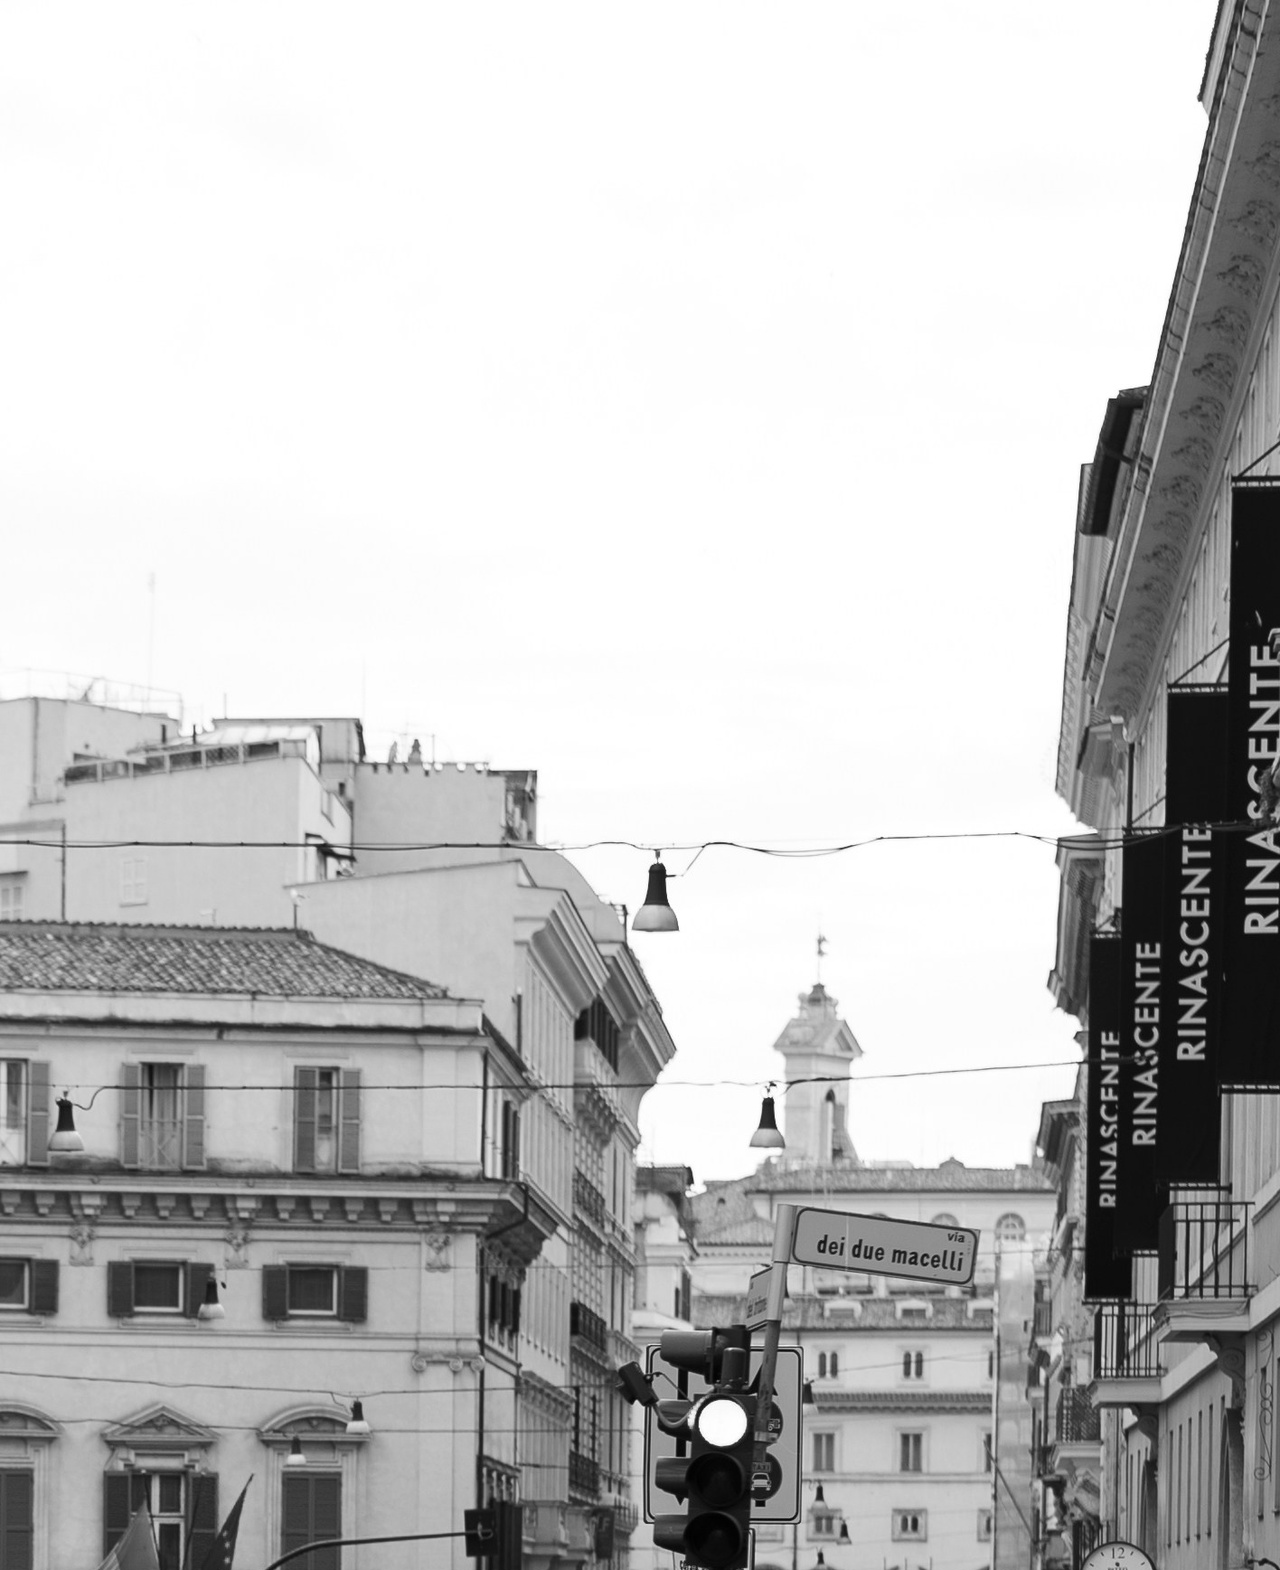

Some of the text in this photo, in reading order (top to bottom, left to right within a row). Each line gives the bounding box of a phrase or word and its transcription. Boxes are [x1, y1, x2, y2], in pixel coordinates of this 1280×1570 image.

[1177, 823, 1213, 1062] RINASCENTE
[1132, 941, 1162, 1146] RINASCENTE
[1099, 1030, 1121, 1208] RINASCENTE
[817, 1234, 964, 1272] dei due macelli
[947, 1232, 966, 1243] via
[1112, 1547, 1125, 1559] 12
